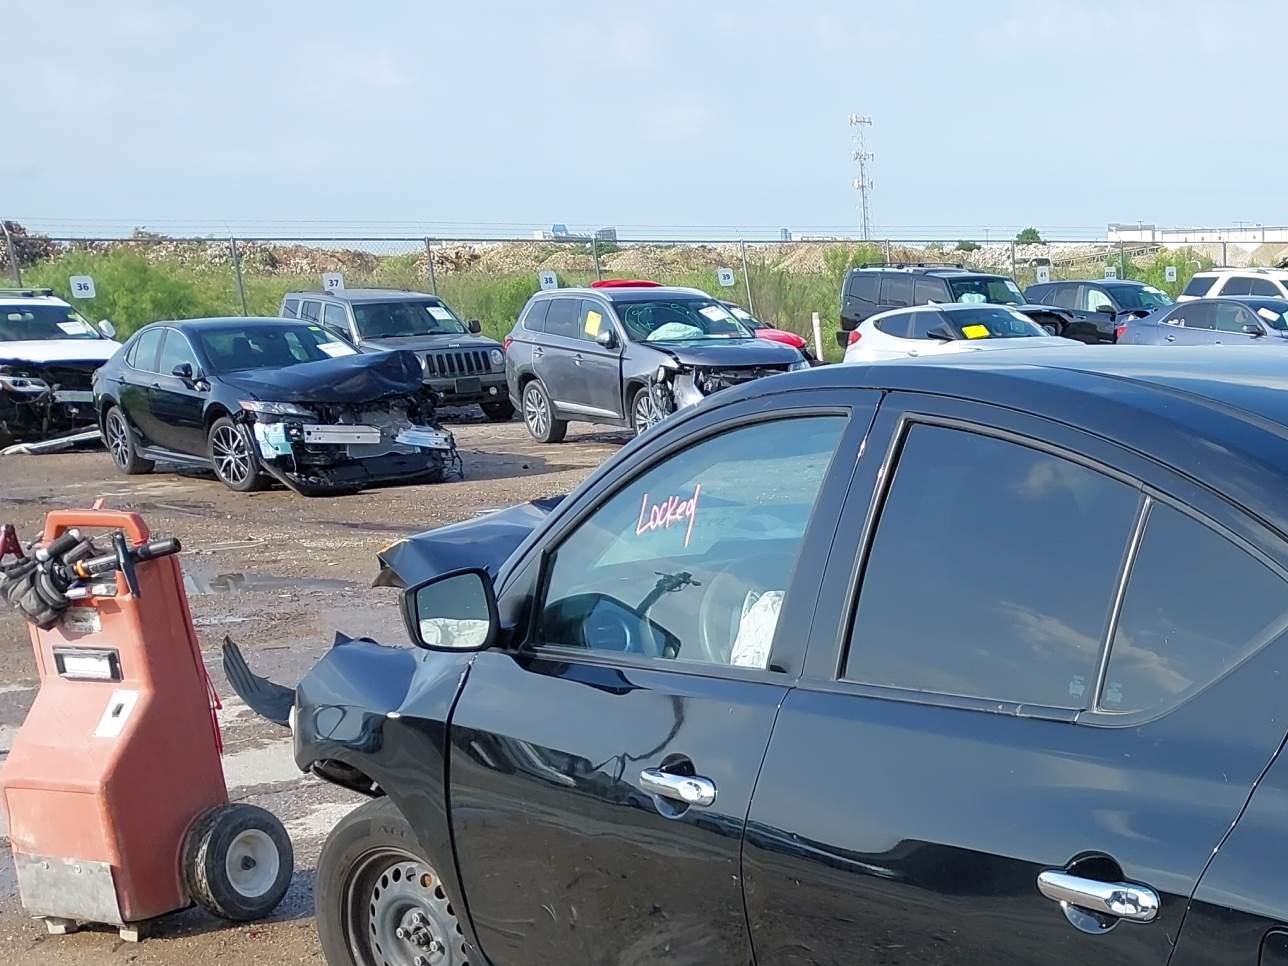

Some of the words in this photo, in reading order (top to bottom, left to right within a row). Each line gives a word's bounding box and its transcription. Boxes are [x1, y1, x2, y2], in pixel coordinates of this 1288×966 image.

[721, 273, 731, 281] 39
[76, 282, 90, 291] 36
[327, 279, 340, 288] 37
[635, 483, 701, 549] Locked
